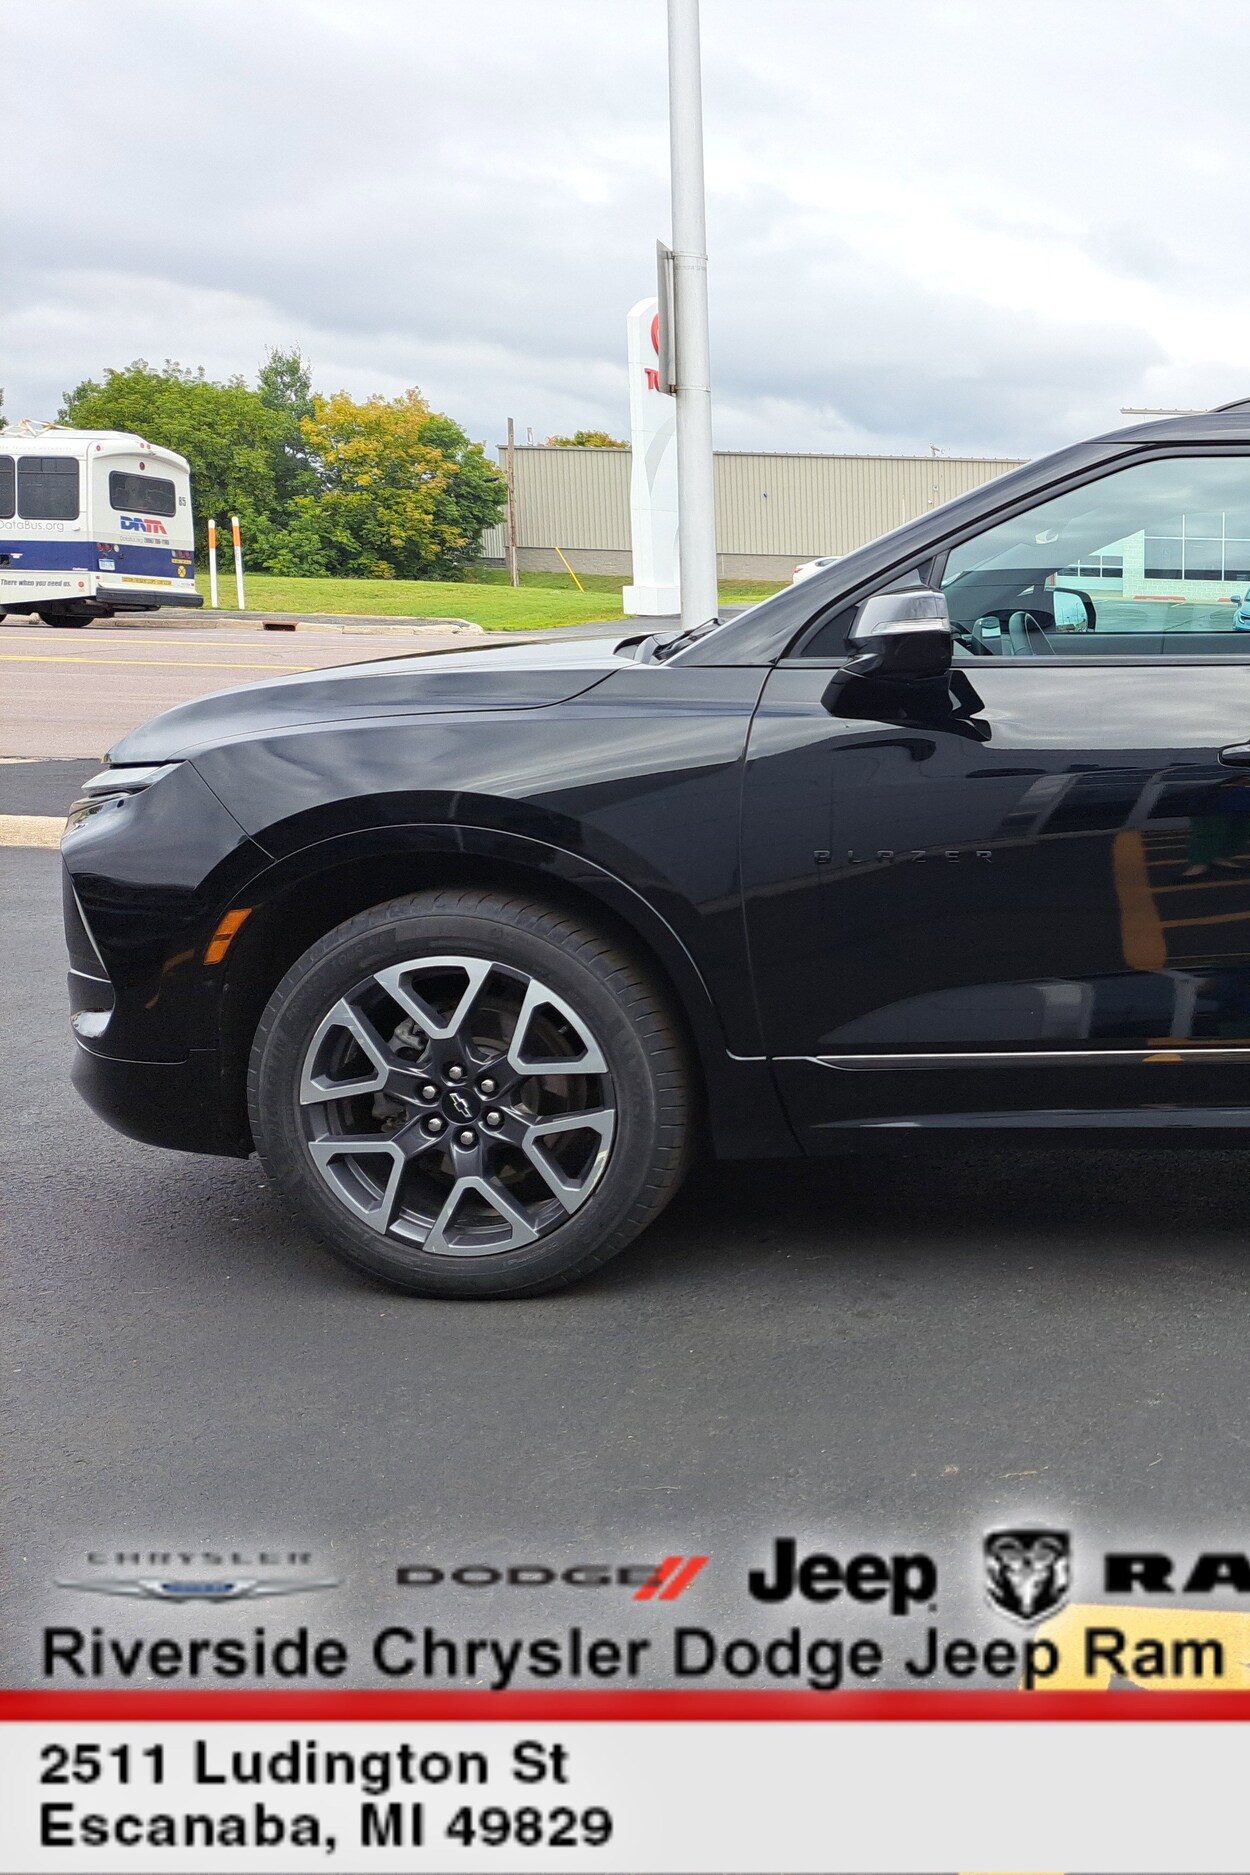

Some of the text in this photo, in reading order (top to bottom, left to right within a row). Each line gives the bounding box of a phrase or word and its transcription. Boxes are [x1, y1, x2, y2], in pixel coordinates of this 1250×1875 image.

[120, 515, 168, 535] DATA
[0, 579, 17, 587] There
[18, 579, 35, 587] when
[35, 580, 46, 588] you
[47, 580, 63, 588] need
[813, 849, 993, 864] BLAZER
